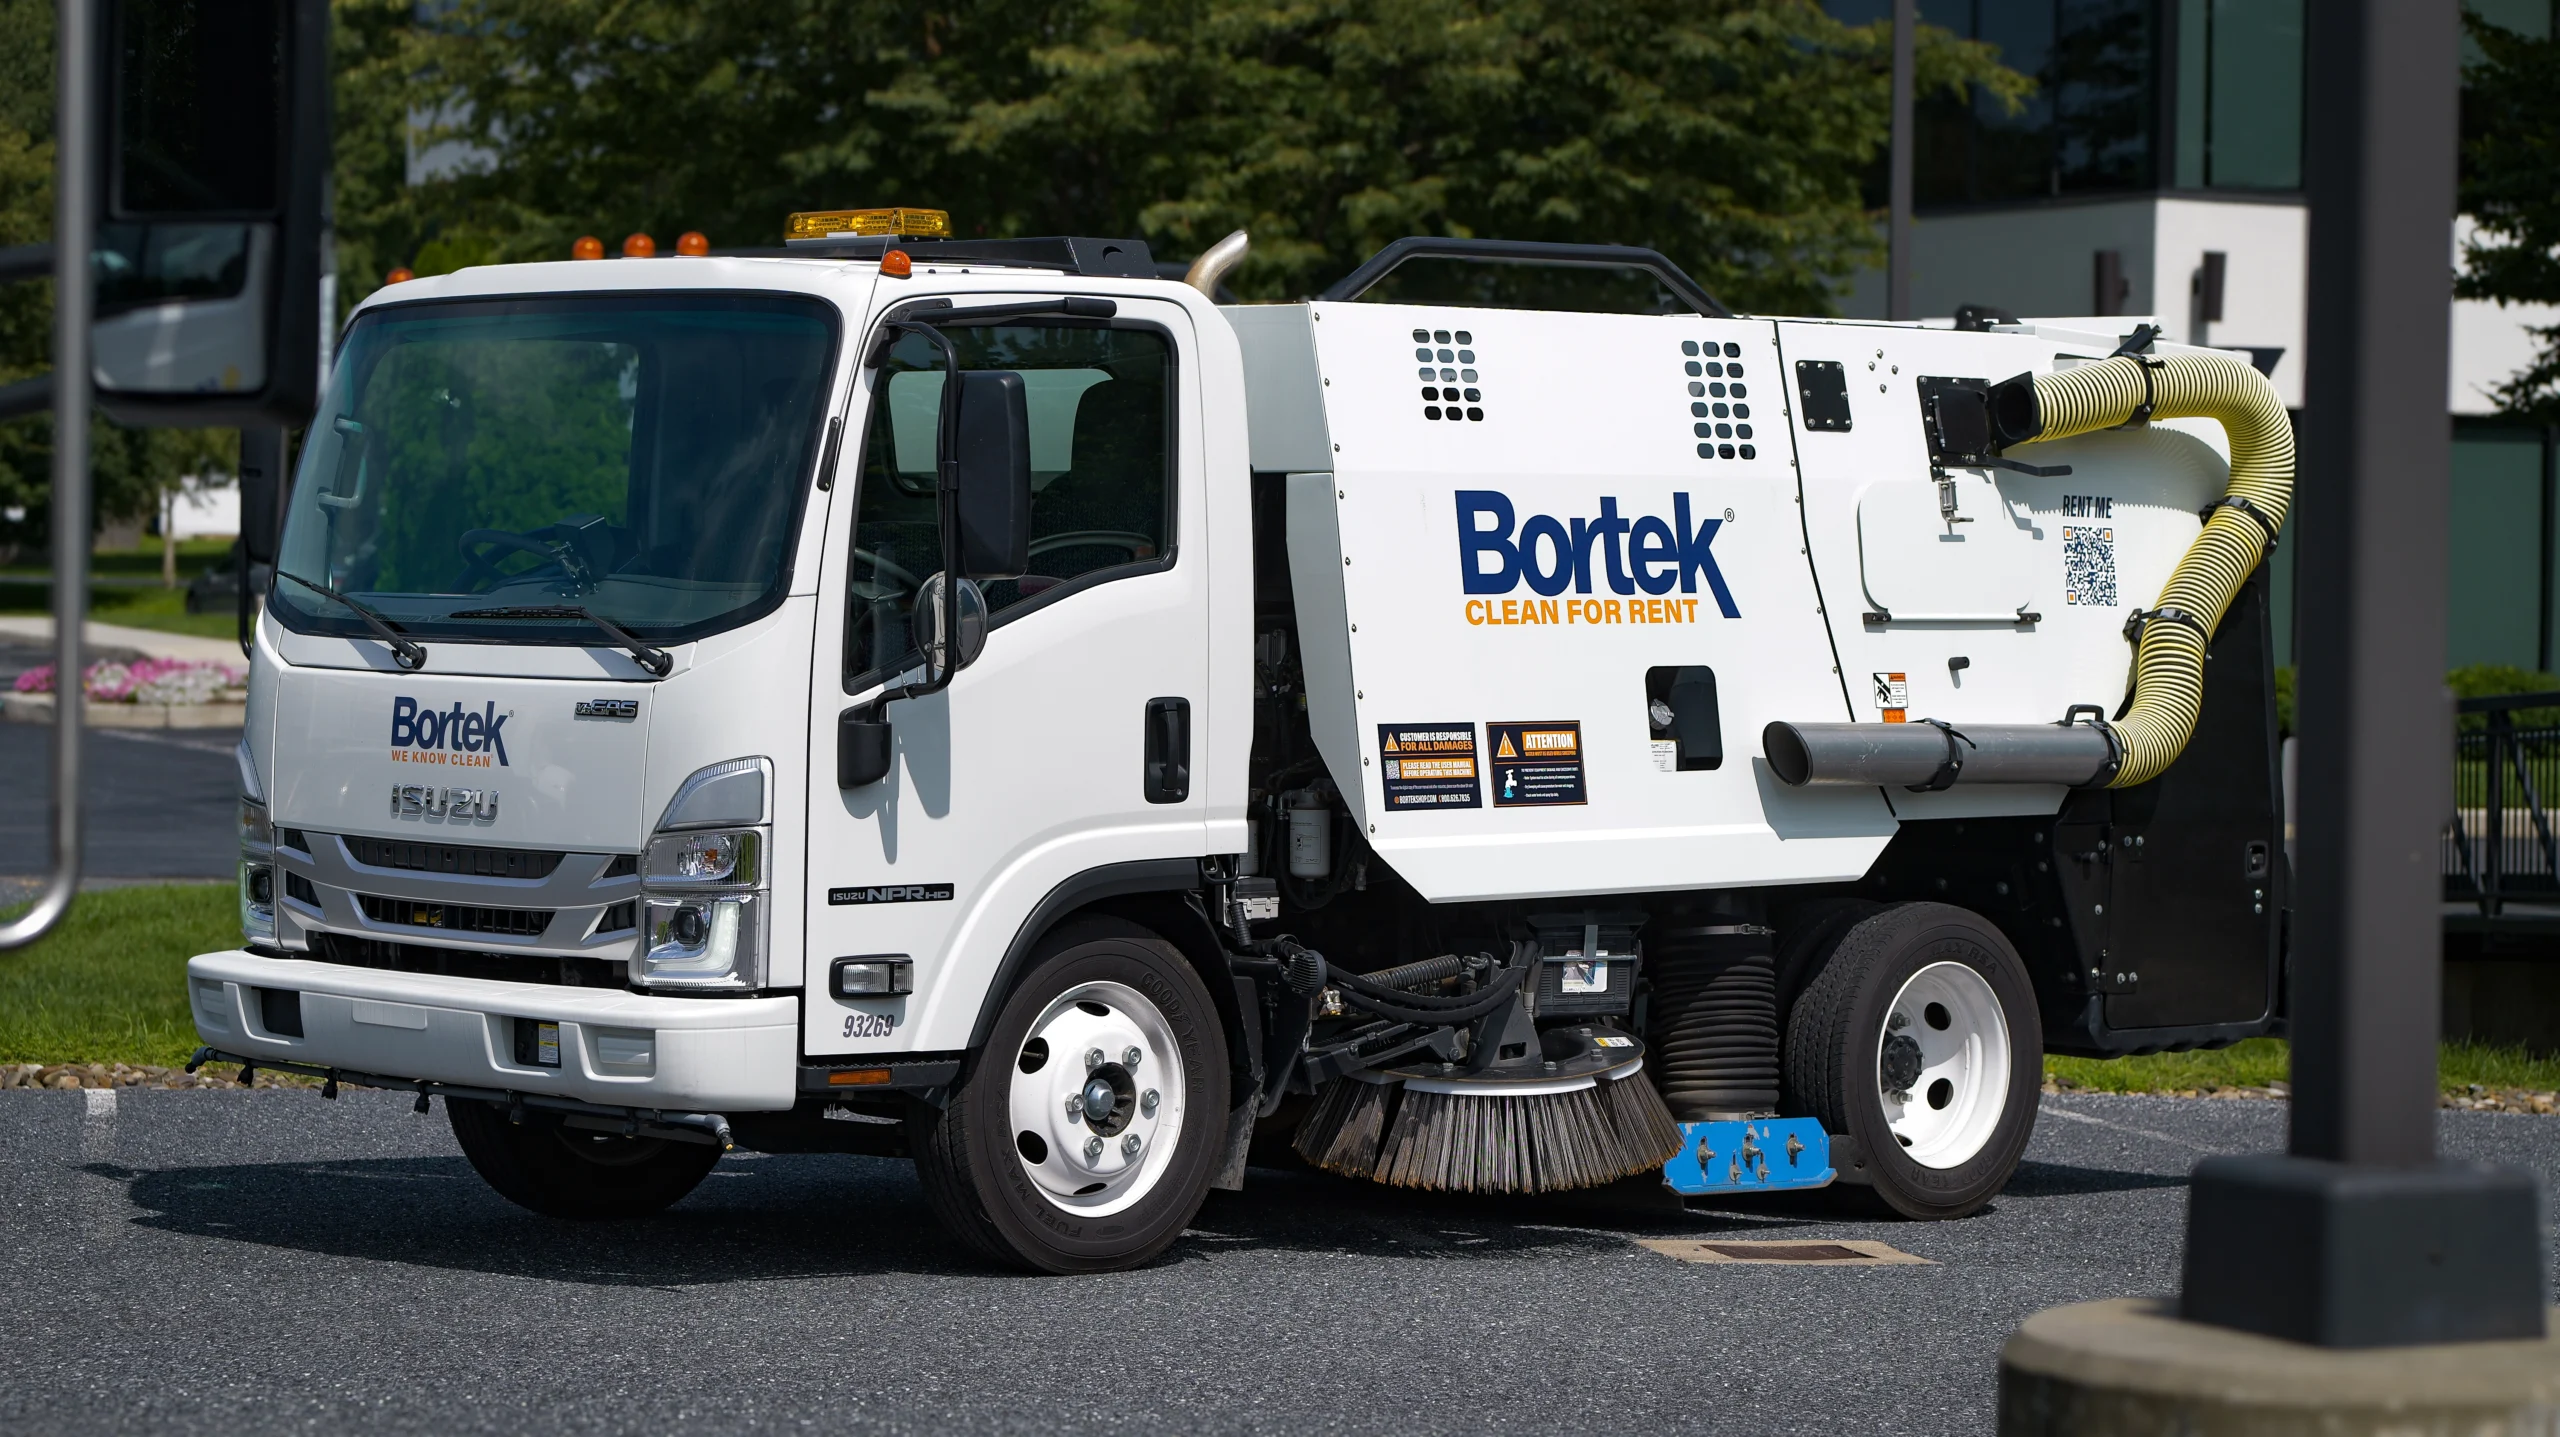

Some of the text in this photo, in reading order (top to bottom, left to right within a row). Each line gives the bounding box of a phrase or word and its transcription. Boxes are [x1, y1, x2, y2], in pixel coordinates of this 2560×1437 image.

[2062, 495, 2113, 519] RENT ME
[1454, 490, 1742, 618] Bortek
[1465, 599, 1699, 625] CLEAN FOR RENT
[591, 700, 637, 717] GAS
[391, 696, 510, 767] Bortek
[1400, 731, 1472, 742] CUSTOMER IS RESPONSIBLE
[1526, 733, 1574, 749] ATTENTION
[1400, 741, 1473, 751] FOR ALL DAMAGES
[391, 750, 491, 768] WE KNOW CLEAN
[391, 783, 500, 823] ISUZU
[833, 886, 950, 902] ISUZU NPR HD
[842, 1014, 895, 1038] 93269
